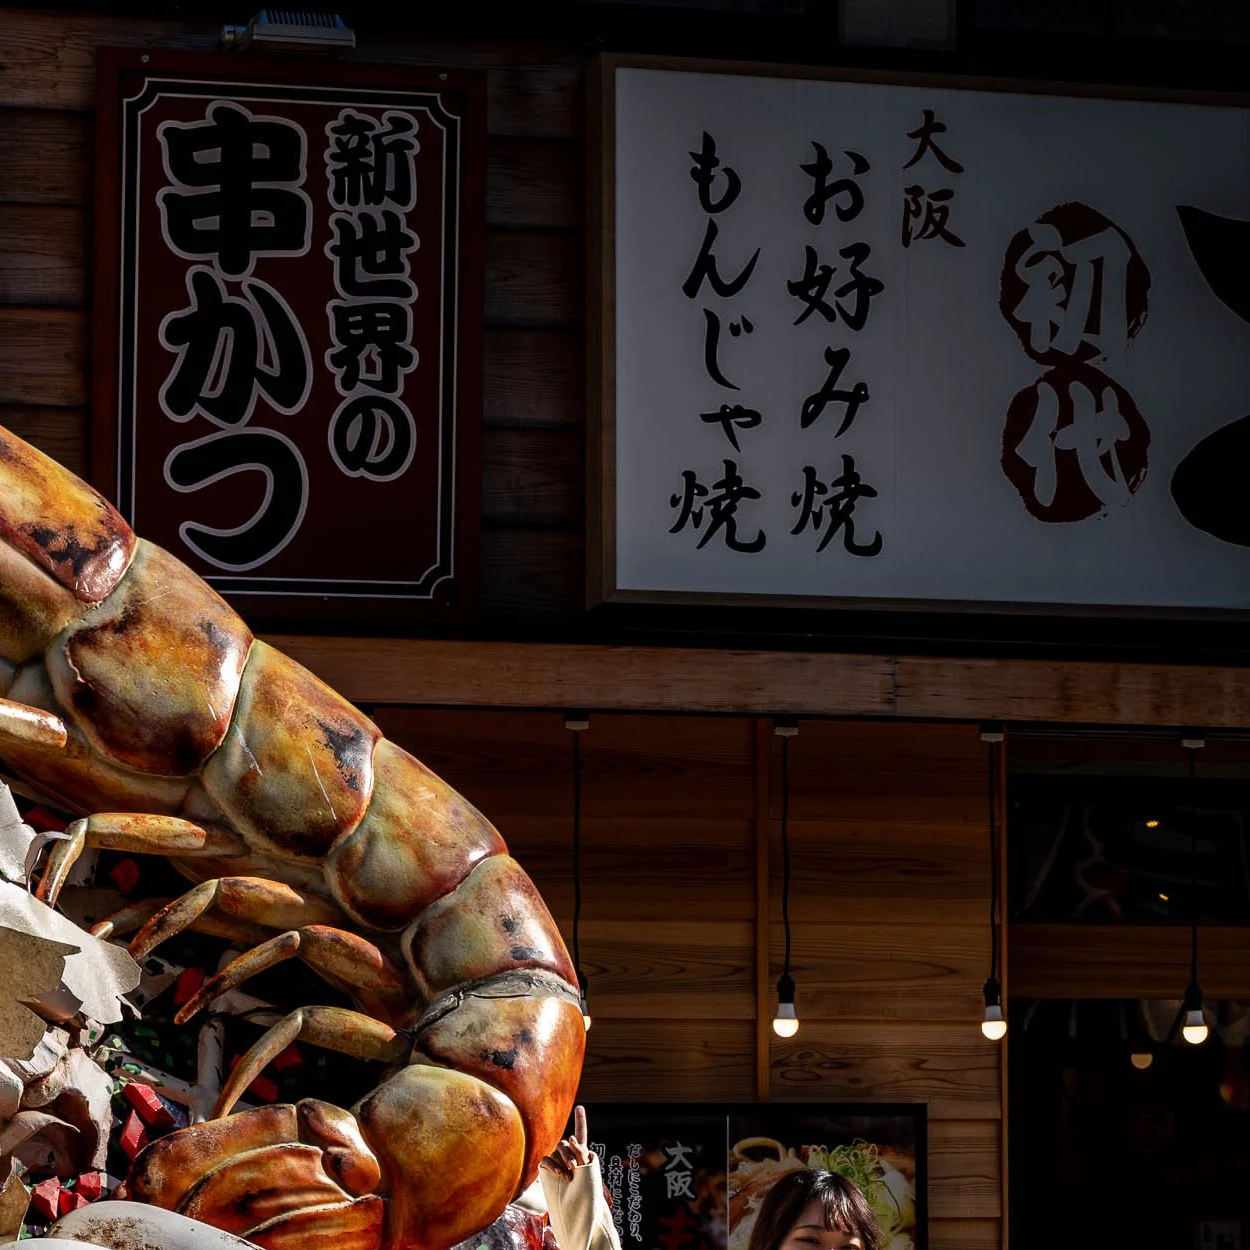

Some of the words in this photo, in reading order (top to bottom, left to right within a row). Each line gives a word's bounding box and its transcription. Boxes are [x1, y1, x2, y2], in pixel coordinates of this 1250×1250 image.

[158, 100, 312, 571] 串かつ
[325, 109, 419, 481] 新世界の
[669, 131, 767, 554] もんじゃ焼
[786, 141, 884, 558] お好み焼
[901, 109, 965, 249] 大阪
[1006, 212, 1141, 516] 初代
[664, 1140, 695, 1199] 大阪
